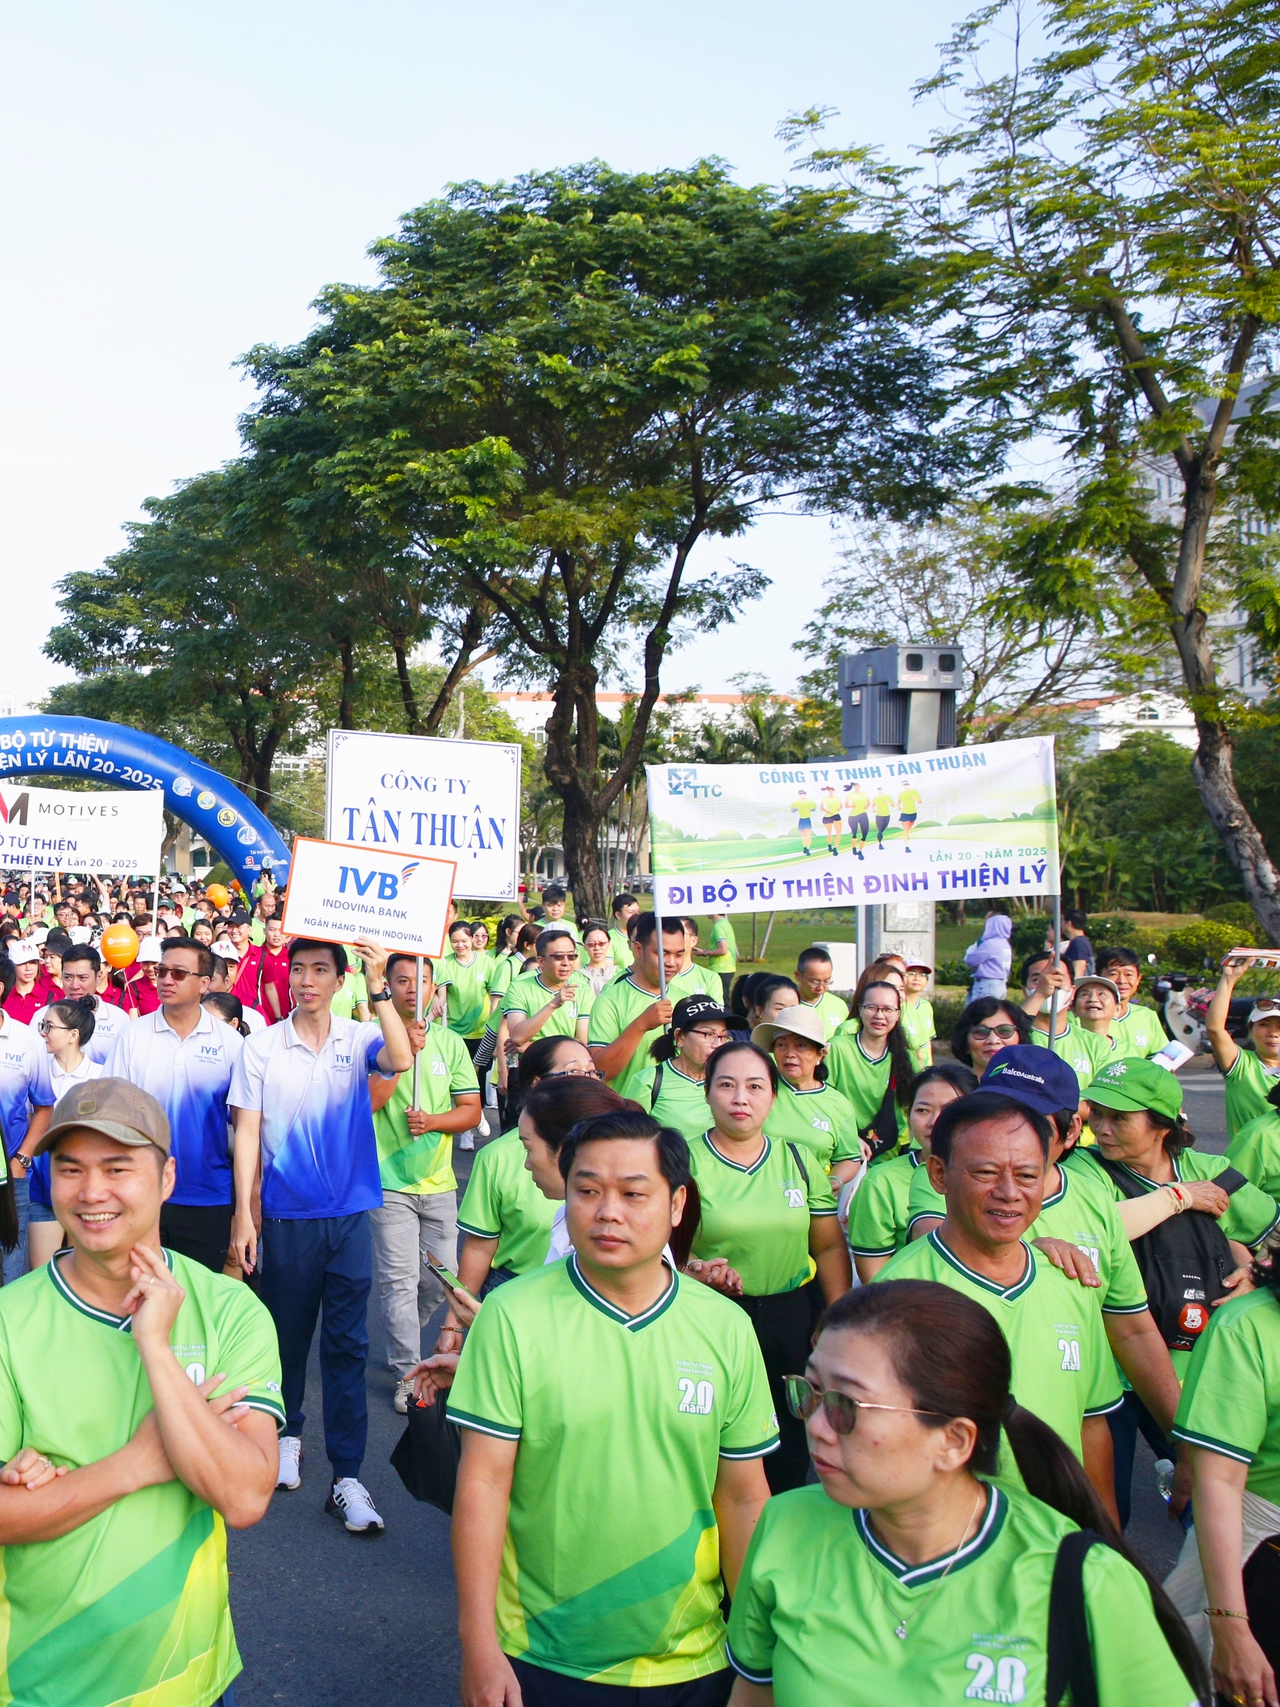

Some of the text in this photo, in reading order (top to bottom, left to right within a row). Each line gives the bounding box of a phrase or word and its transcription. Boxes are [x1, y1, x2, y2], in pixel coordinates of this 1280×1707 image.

[0, 729, 26, 752] BỘ
[30, 728, 56, 748] TỪ
[27, 749, 48, 766] LÝ
[759, 751, 987, 784] CÔNG TY TNHH TÂN THUẬN
[380, 770, 471, 794] CÔNG TY
[692, 784, 723, 798] TTC
[38, 802, 118, 817] MOTIVES
[342, 796, 506, 858] TÂN THUẬN
[8, 834, 30, 848] TỪ
[32, 837, 78, 854] THIỆN
[1, 853, 44, 868] THIỆN
[47, 852, 63, 867] LÝ
[90, 858, 103, 867] 20
[112, 860, 138, 868] 2025
[958, 852, 972, 861] 20
[984, 847, 1013, 859] NĂM
[1018, 846, 1048, 856] 2025
[338, 866, 398, 900] IVB
[668, 858, 1048, 908] ĐI BỘ TỪ THIỆN ĐINH THIỆN LÝ
[322, 898, 408, 920] INDOVINA BANK
[304, 917, 423, 943] NGÂN HÀNG TNHH INDOVINA
[98, 1024, 112, 1032] IVB
[5, 1052, 22, 1062] IVB
[200, 1046, 218, 1056] IVB
[336, 1054, 350, 1064] IVB
[431, 1060, 446, 1076] 20
[1074, 1058, 1090, 1074] 20
[678, 1376, 714, 1415] 20
[682, 1402, 706, 1414] năm
[965, 1652, 1028, 1704] 20
[969, 1684, 1015, 1702] năm
